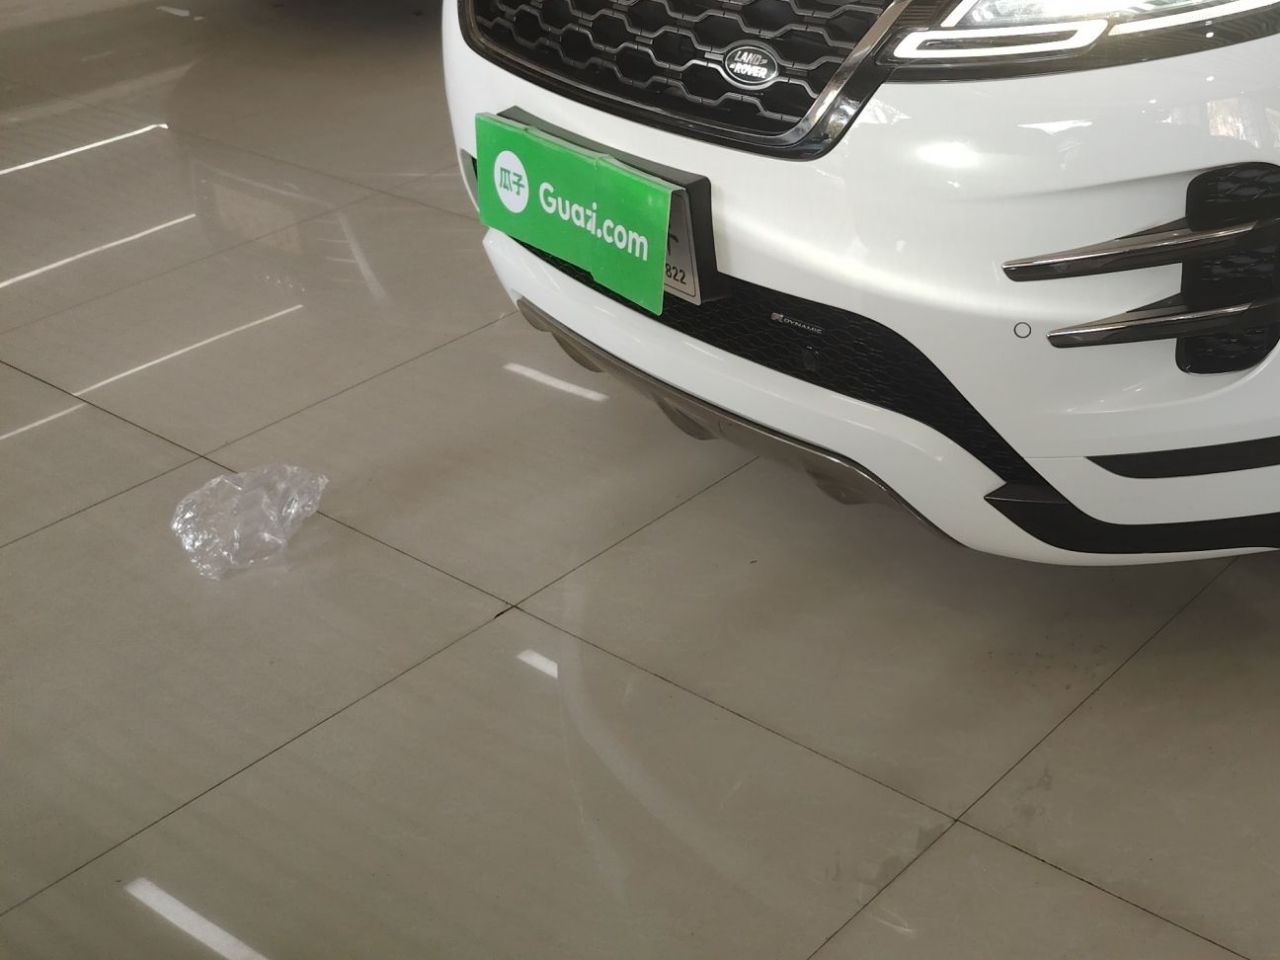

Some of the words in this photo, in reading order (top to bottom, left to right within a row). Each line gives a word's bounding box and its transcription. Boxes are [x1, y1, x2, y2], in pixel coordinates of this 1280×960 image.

[733, 62, 768, 79] ROVER
[734, 50, 763, 66] LAND
[498, 165, 526, 202] 瓜子
[538, 180, 650, 262] Guazi.com
